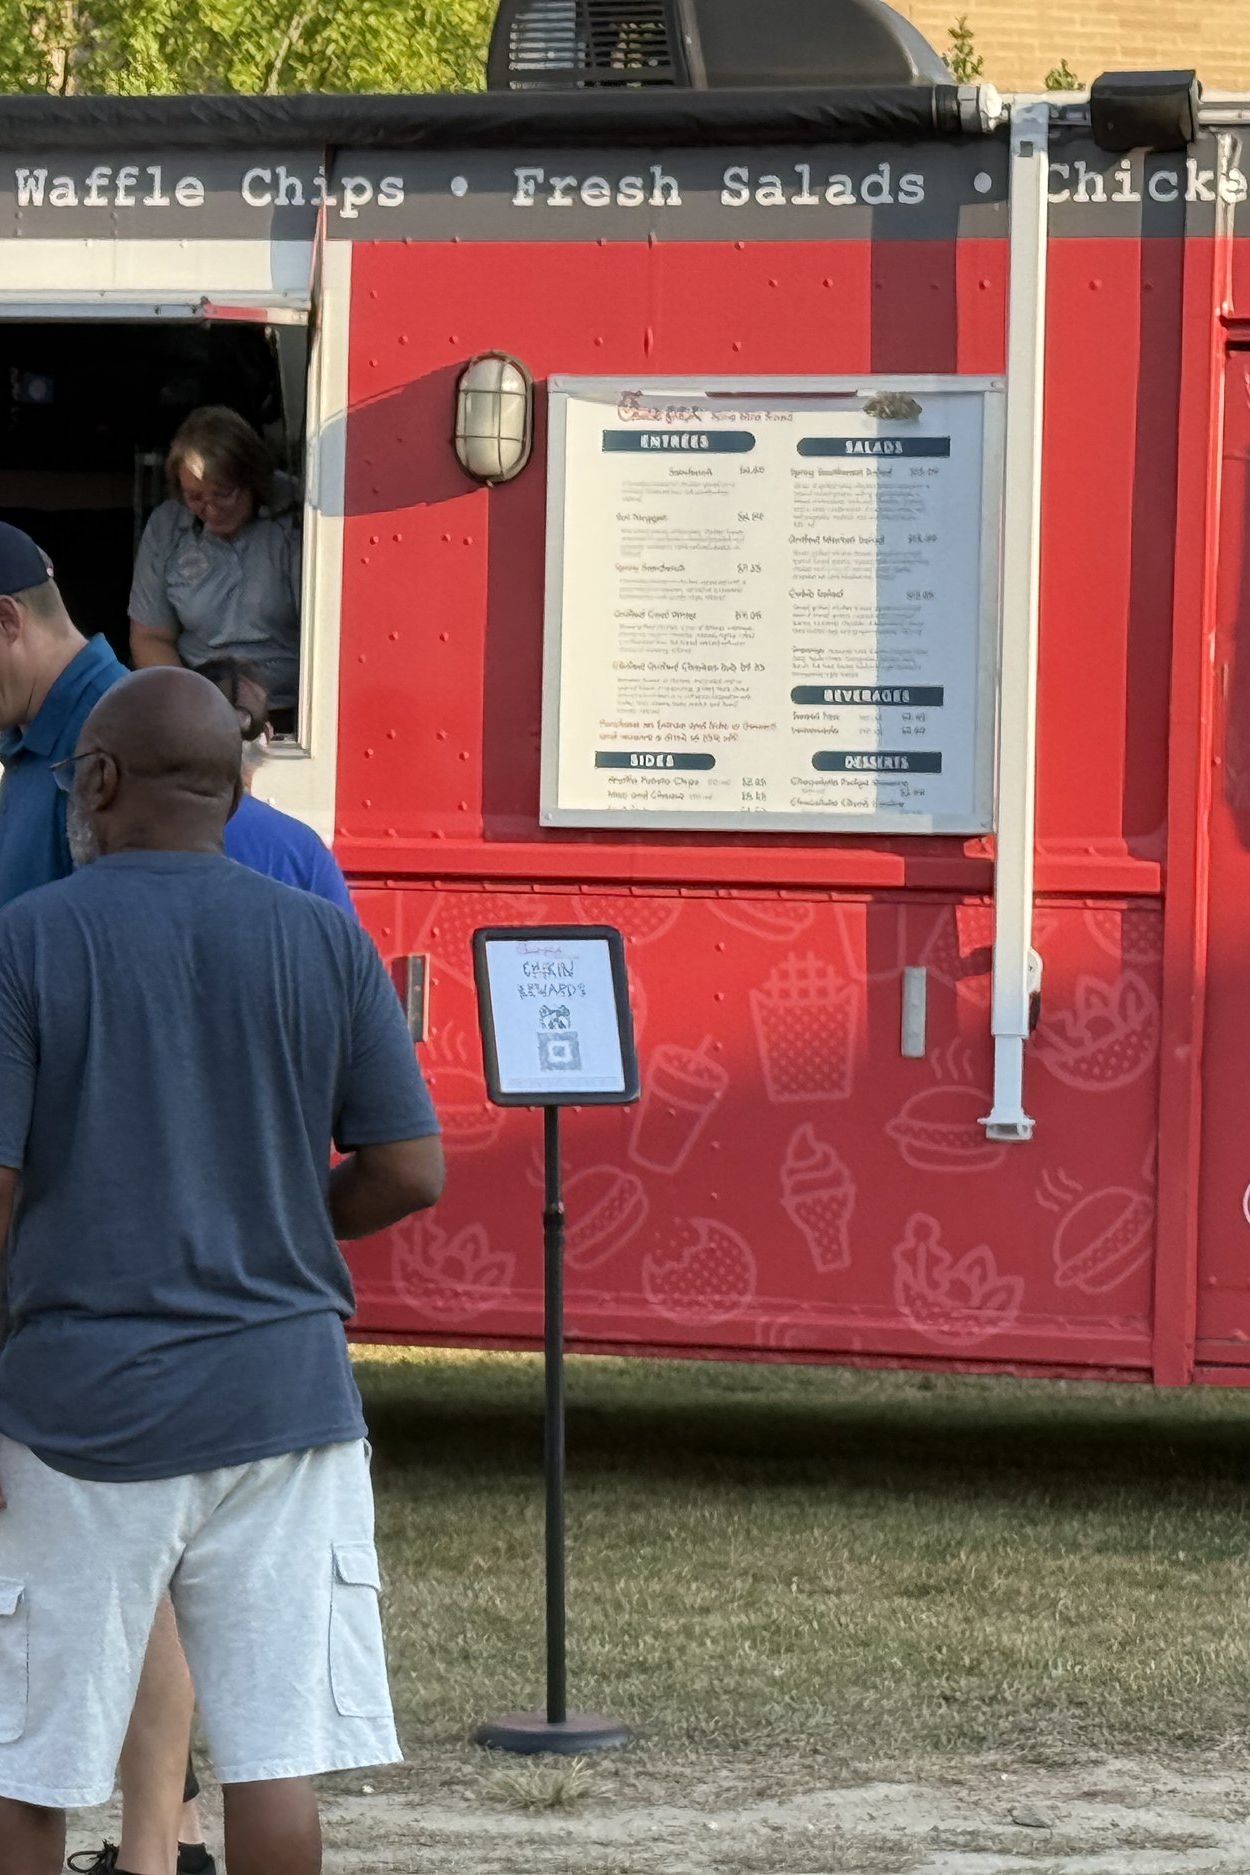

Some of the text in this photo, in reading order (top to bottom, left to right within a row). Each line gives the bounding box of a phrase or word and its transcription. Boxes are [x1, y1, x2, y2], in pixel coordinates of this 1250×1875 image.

[15, 165, 207, 207] Waffle
[241, 165, 405, 218] Chips
[513, 164, 682, 207] Fresh
[720, 163, 926, 206] Salads
[845, 440, 903, 454] SALADS
[630, 754, 674, 767] SIDES
